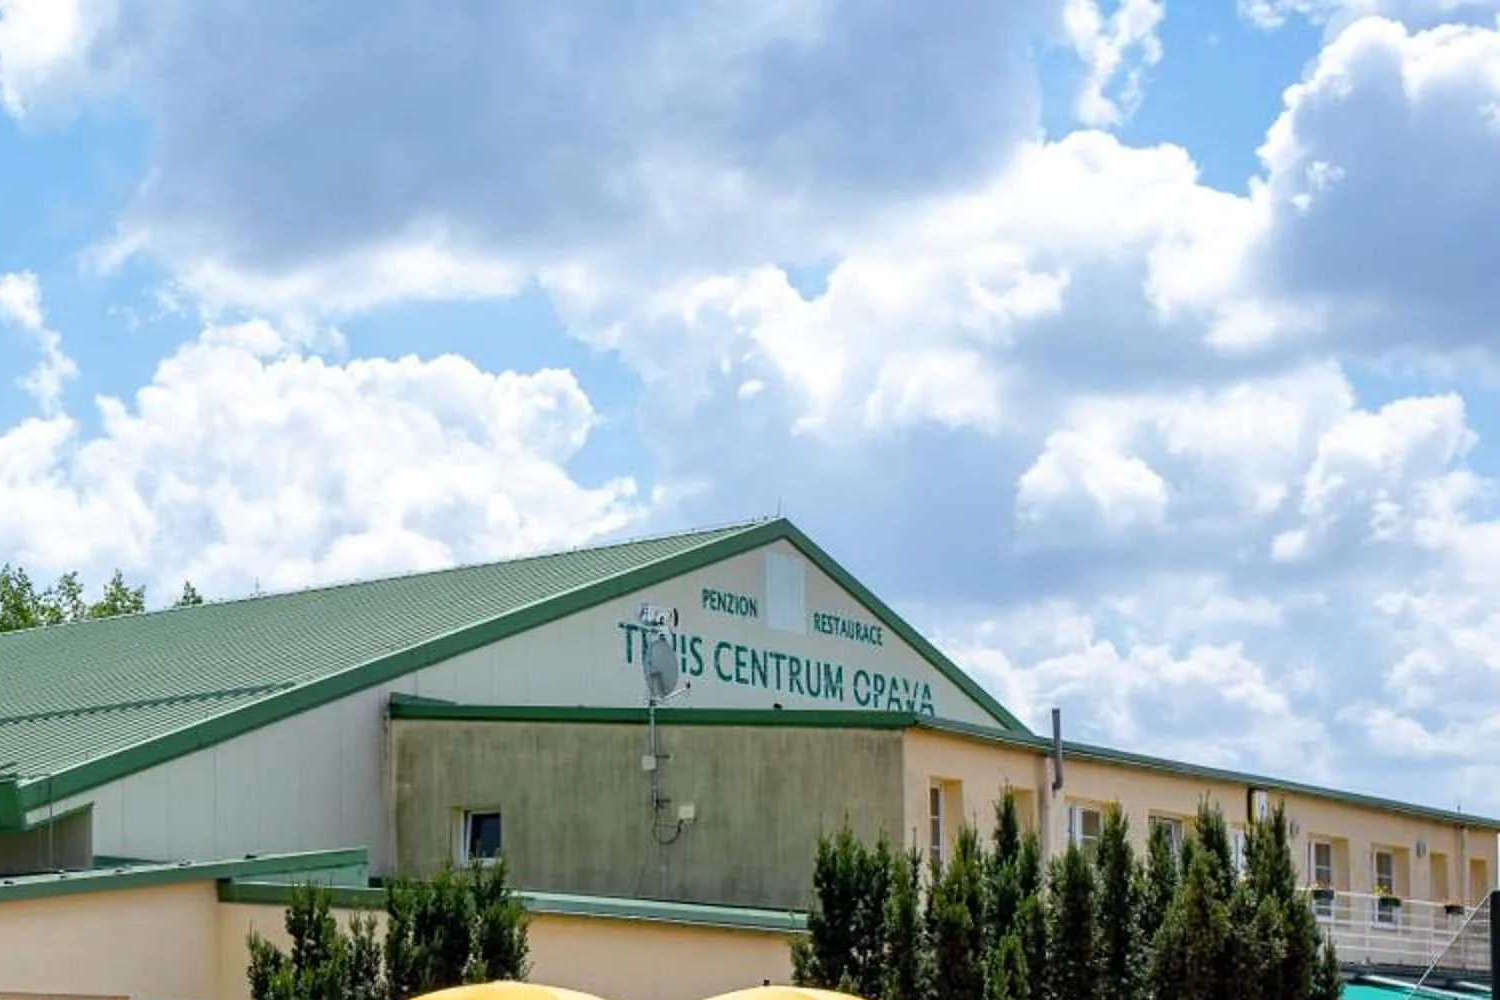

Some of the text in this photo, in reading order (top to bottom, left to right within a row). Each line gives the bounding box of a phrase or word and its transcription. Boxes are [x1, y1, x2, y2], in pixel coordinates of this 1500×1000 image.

[702, 588, 758, 618] PENZION
[814, 612, 884, 647] RESTAURACE
[714, 640, 844, 701] CENTRUM
[853, 669, 935, 717] OPAVA
